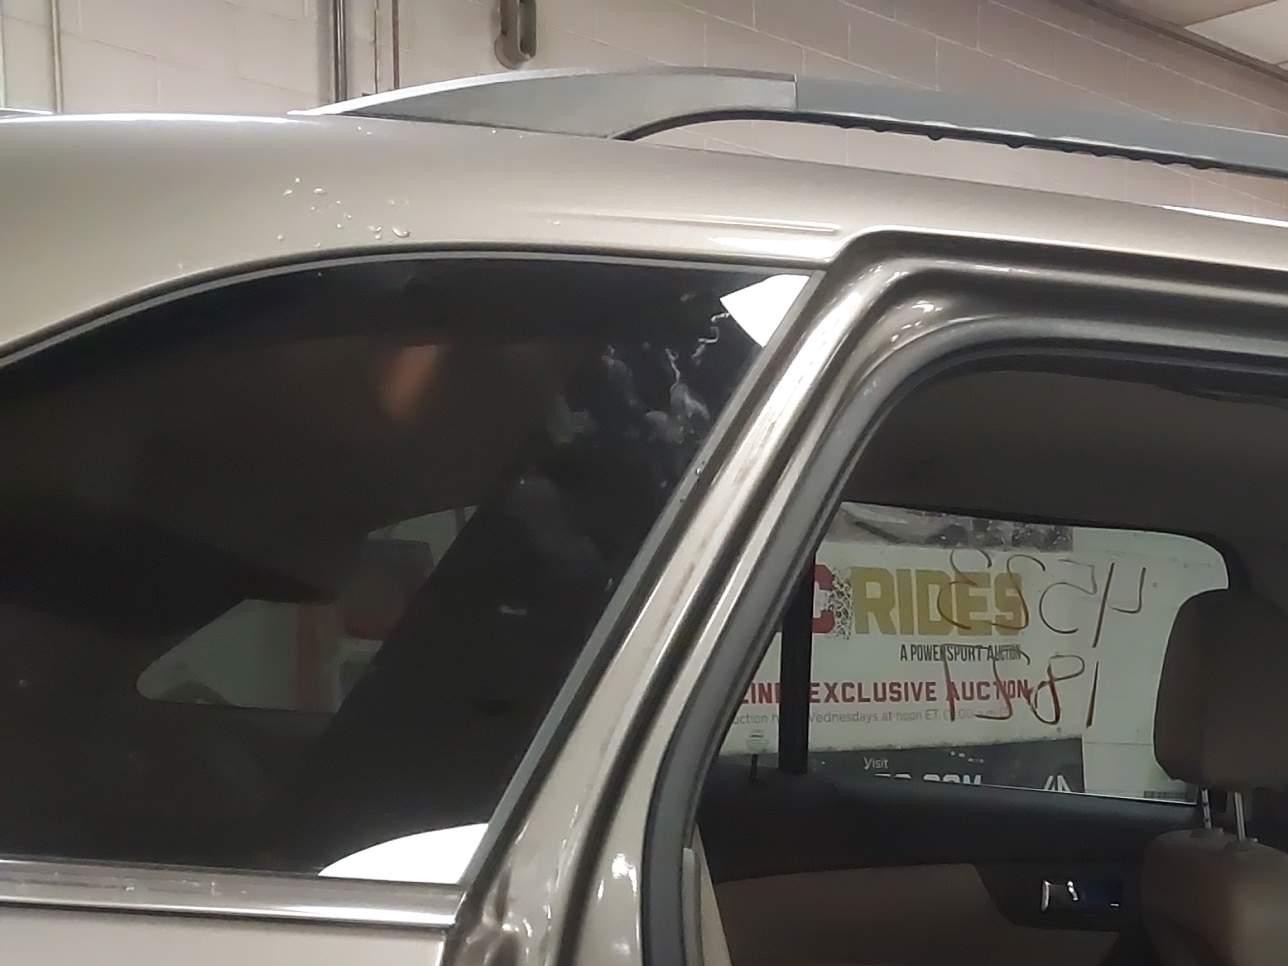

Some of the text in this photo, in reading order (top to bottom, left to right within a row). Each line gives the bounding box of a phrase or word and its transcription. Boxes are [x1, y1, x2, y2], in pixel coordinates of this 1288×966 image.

[852, 566, 1023, 636] RIDES
[900, 644, 908, 662] A
[809, 679, 937, 703] EXCLUSIVE
[946, 678, 1028, 701] AUCTION
[863, 756, 889, 770] Visit
